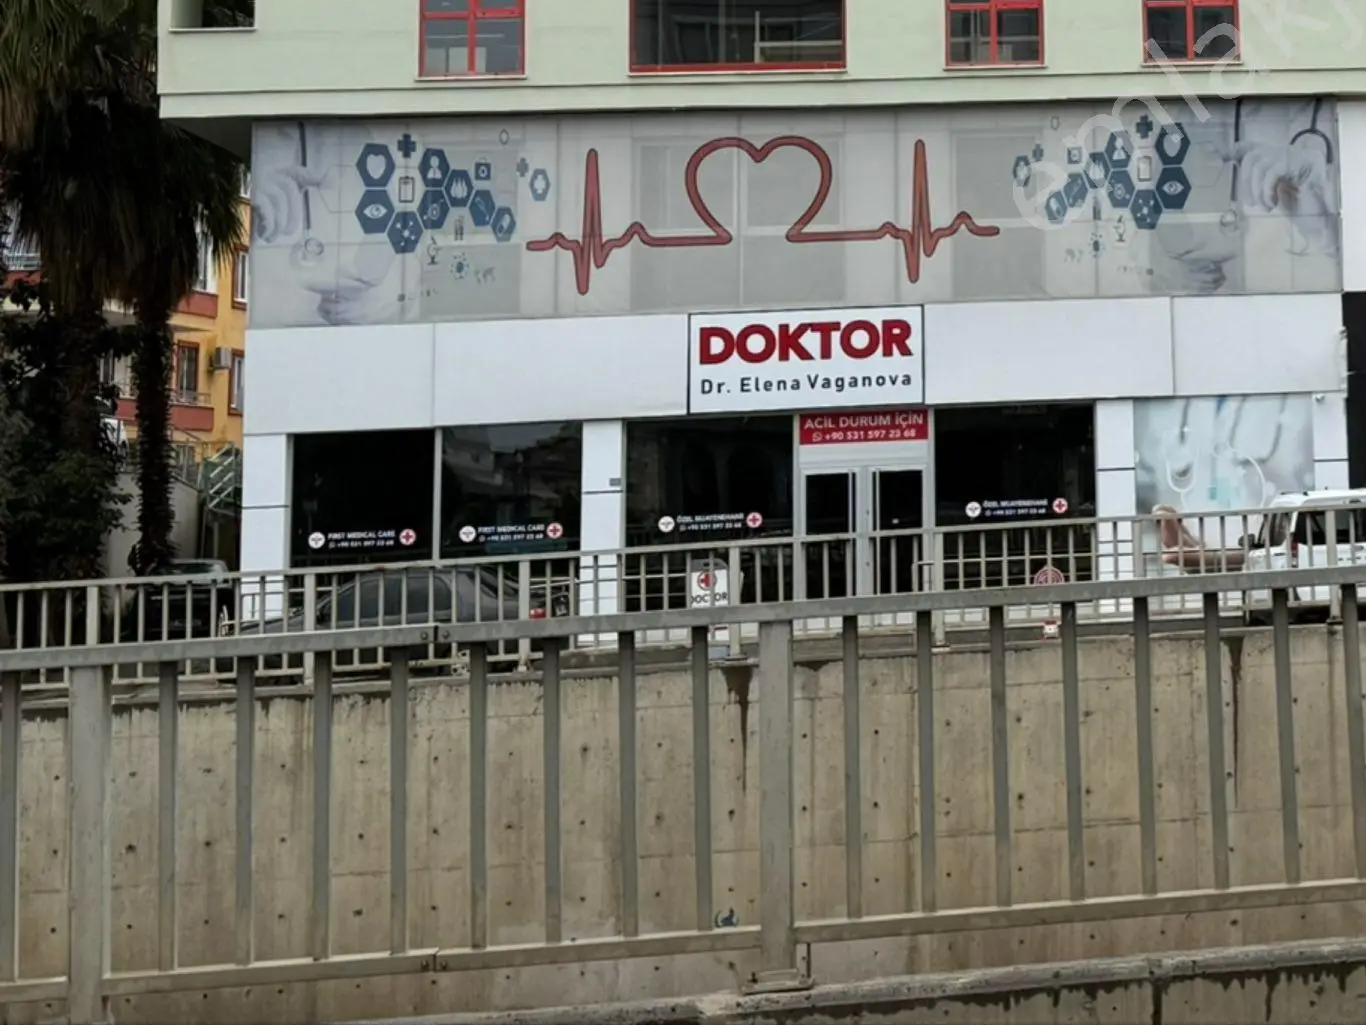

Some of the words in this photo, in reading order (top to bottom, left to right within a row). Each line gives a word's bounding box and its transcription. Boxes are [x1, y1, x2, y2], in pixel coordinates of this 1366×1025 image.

[699, 319, 914, 365] DOKTOR
[701, 378, 731, 394] Dr.
[740, 376, 801, 393] Elena
[807, 374, 912, 392] Vaganova
[804, 416, 836, 430] ACİL
[840, 415, 891, 428] DURUM
[895, 412, 923, 429] İÇİN
[825, 431, 844, 440] +90
[690, 592, 728, 604] OCOR
